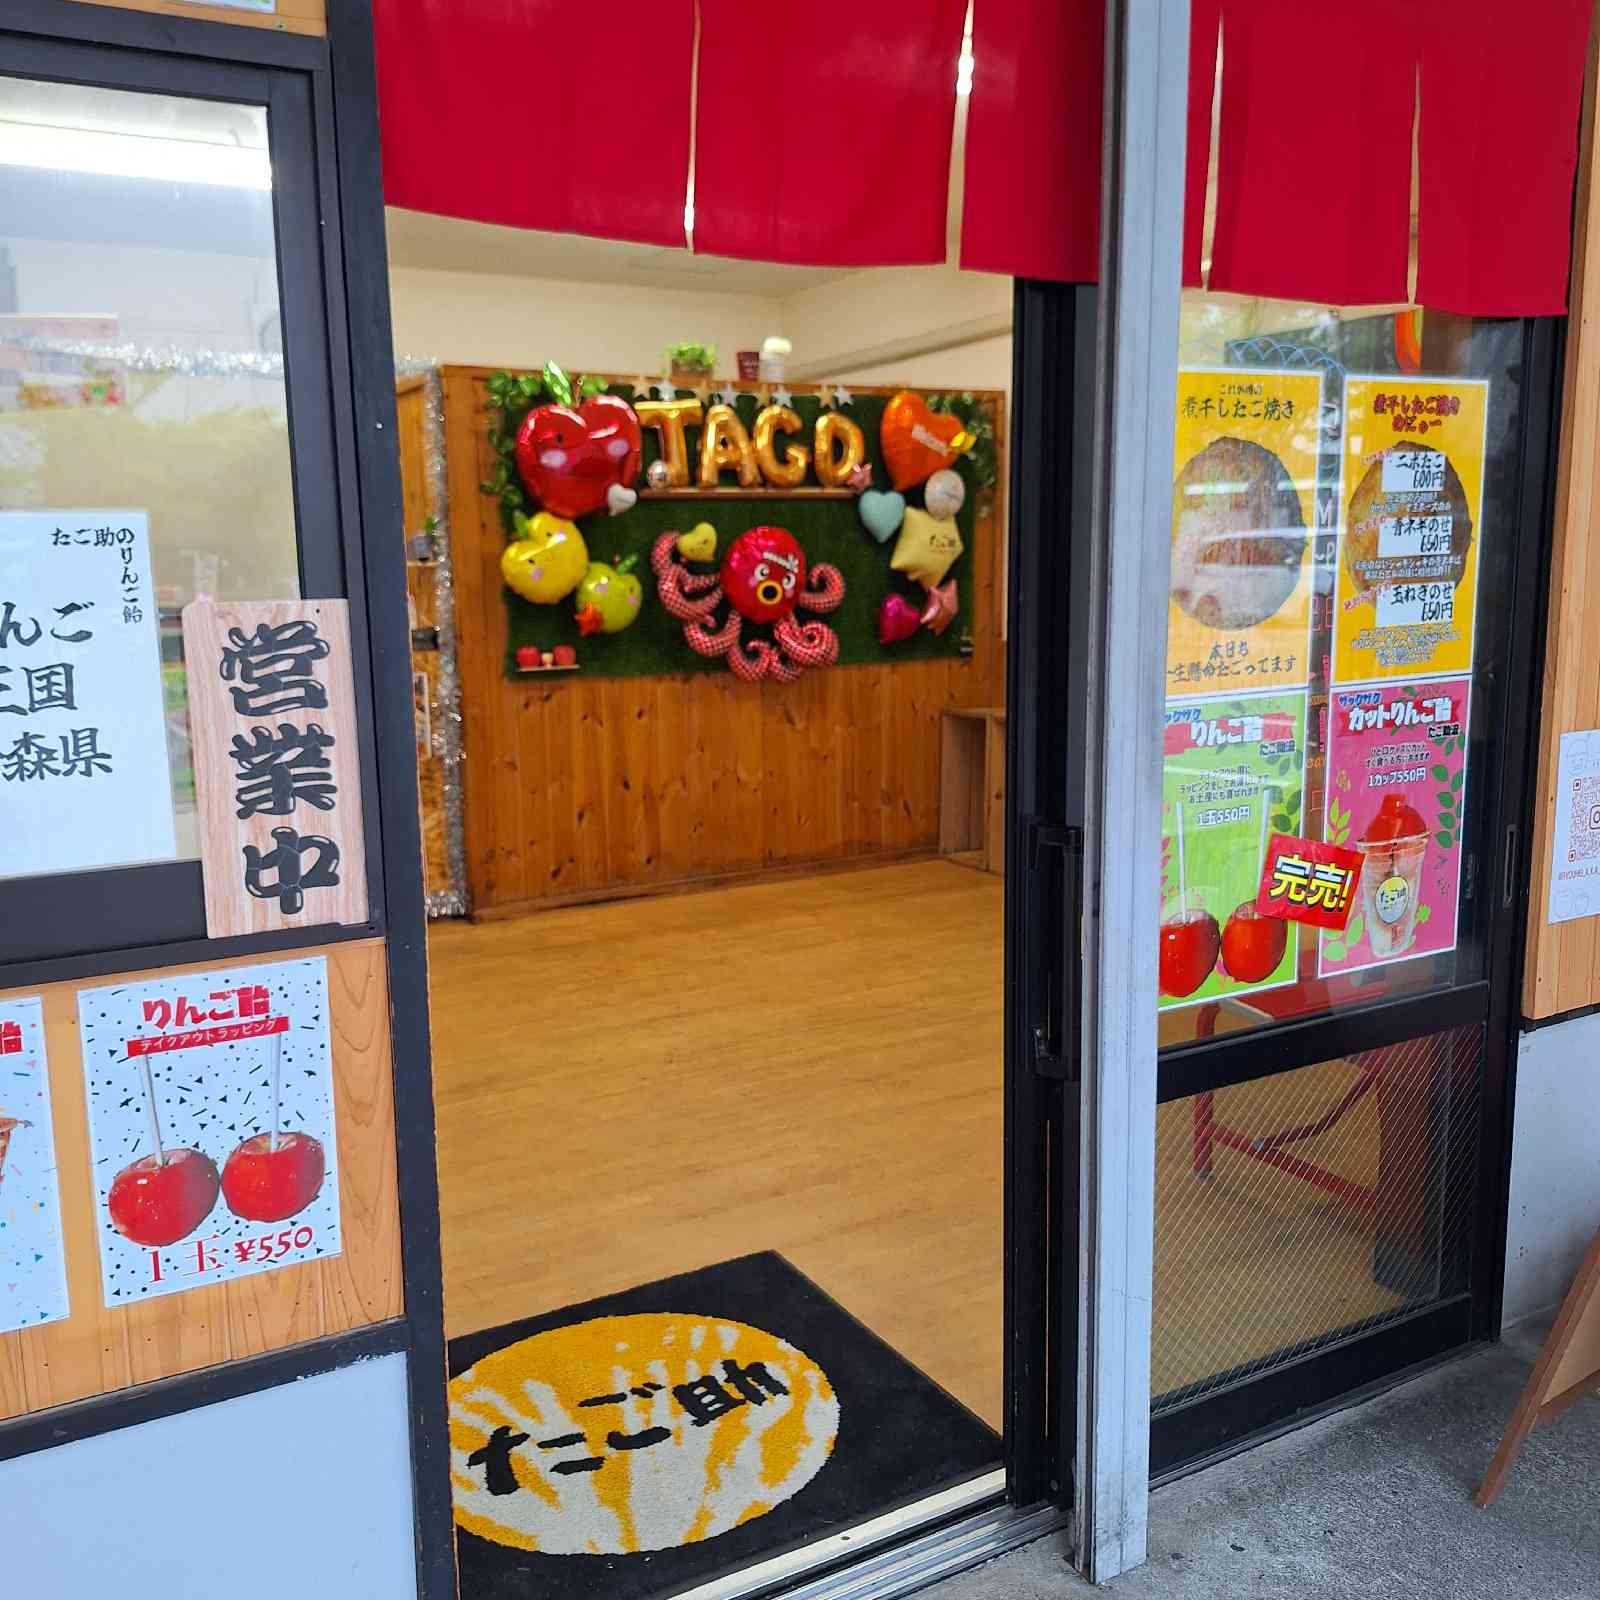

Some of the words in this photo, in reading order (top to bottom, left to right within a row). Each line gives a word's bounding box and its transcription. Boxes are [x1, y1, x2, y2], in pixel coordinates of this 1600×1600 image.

[219, 620, 341, 915] 営業中
[1368, 767, 1426, 787] 1カップ550円
[1268, 853, 1356, 912] 完売!
[142, 984, 270, 1030] りんご飴
[139, 1018, 278, 1051] テイクアウトラッピング
